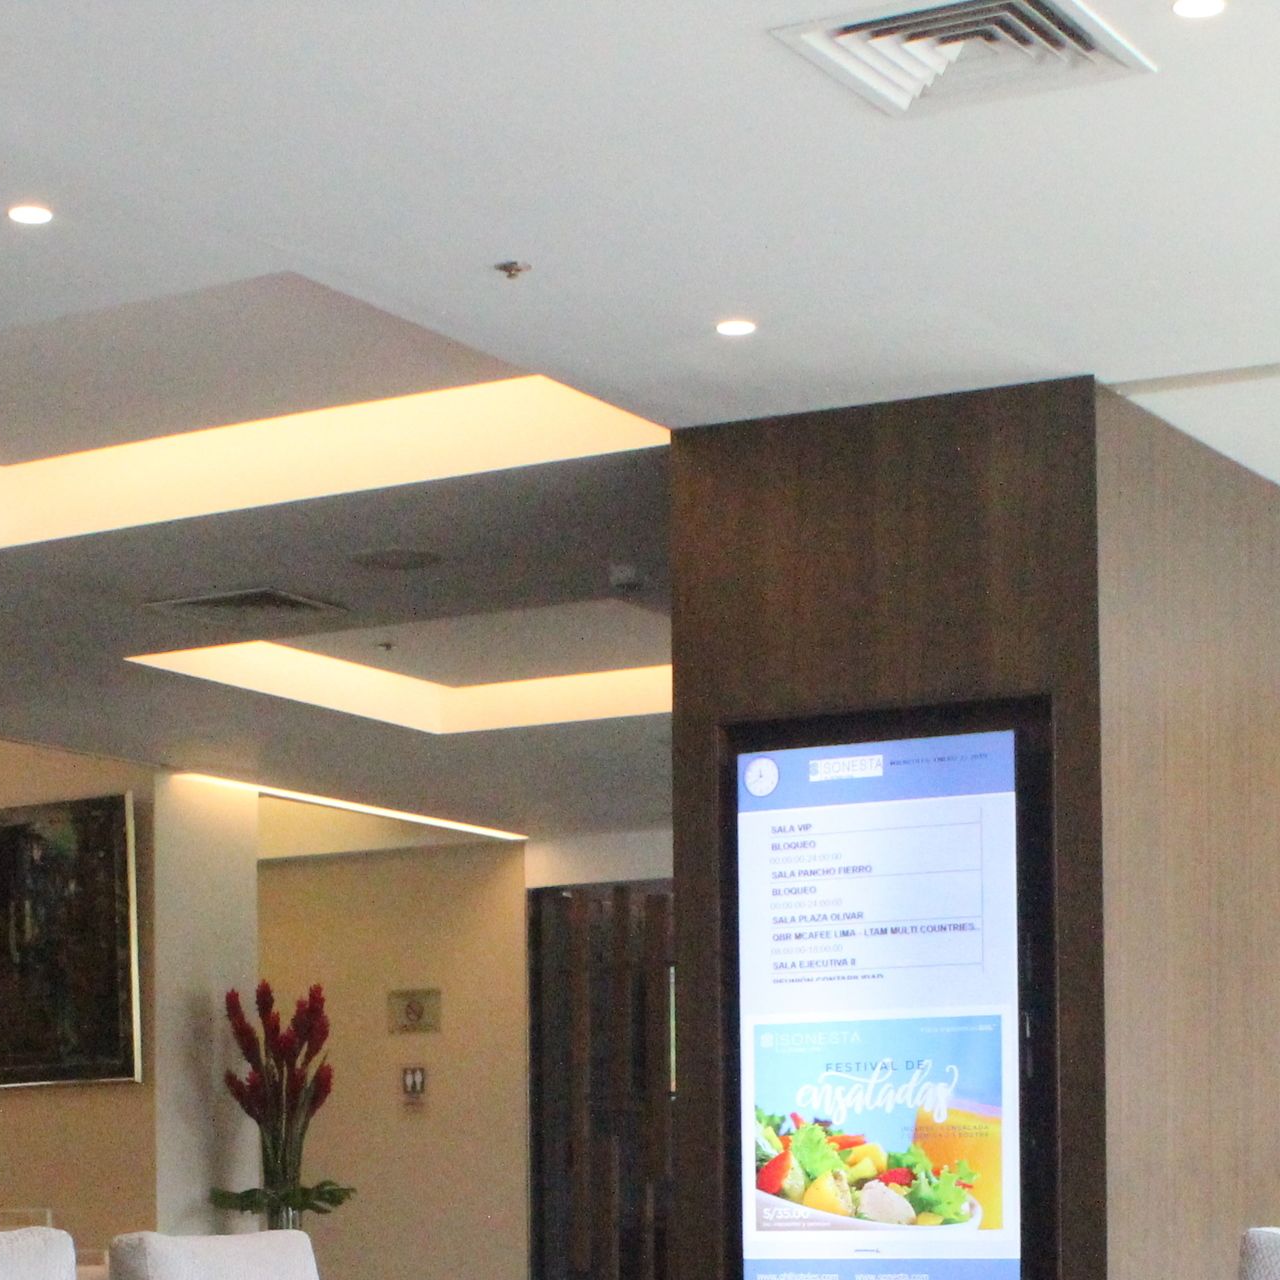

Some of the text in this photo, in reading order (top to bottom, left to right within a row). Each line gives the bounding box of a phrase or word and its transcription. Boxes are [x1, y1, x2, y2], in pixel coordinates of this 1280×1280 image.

[823, 757, 882, 774] SONESTA
[771, 823, 812, 834] SALA VIP
[771, 840, 816, 851] BLOQUEO
[771, 865, 872, 879] SALA PANCHO FIERRO
[772, 886, 817, 896] BLOQUEO
[772, 911, 864, 925] SALA PLAZA OLIVAR
[794, 930, 832, 940] MCAFEE
[834, 929, 856, 938] LIMA
[890, 925, 917, 935] MULTI
[773, 961, 796, 970] SALA
[798, 958, 848, 968] EJECUTIVA
[779, 1031, 861, 1045] SONESTA
[825, 1059, 925, 1072] FESTIVAL DE
